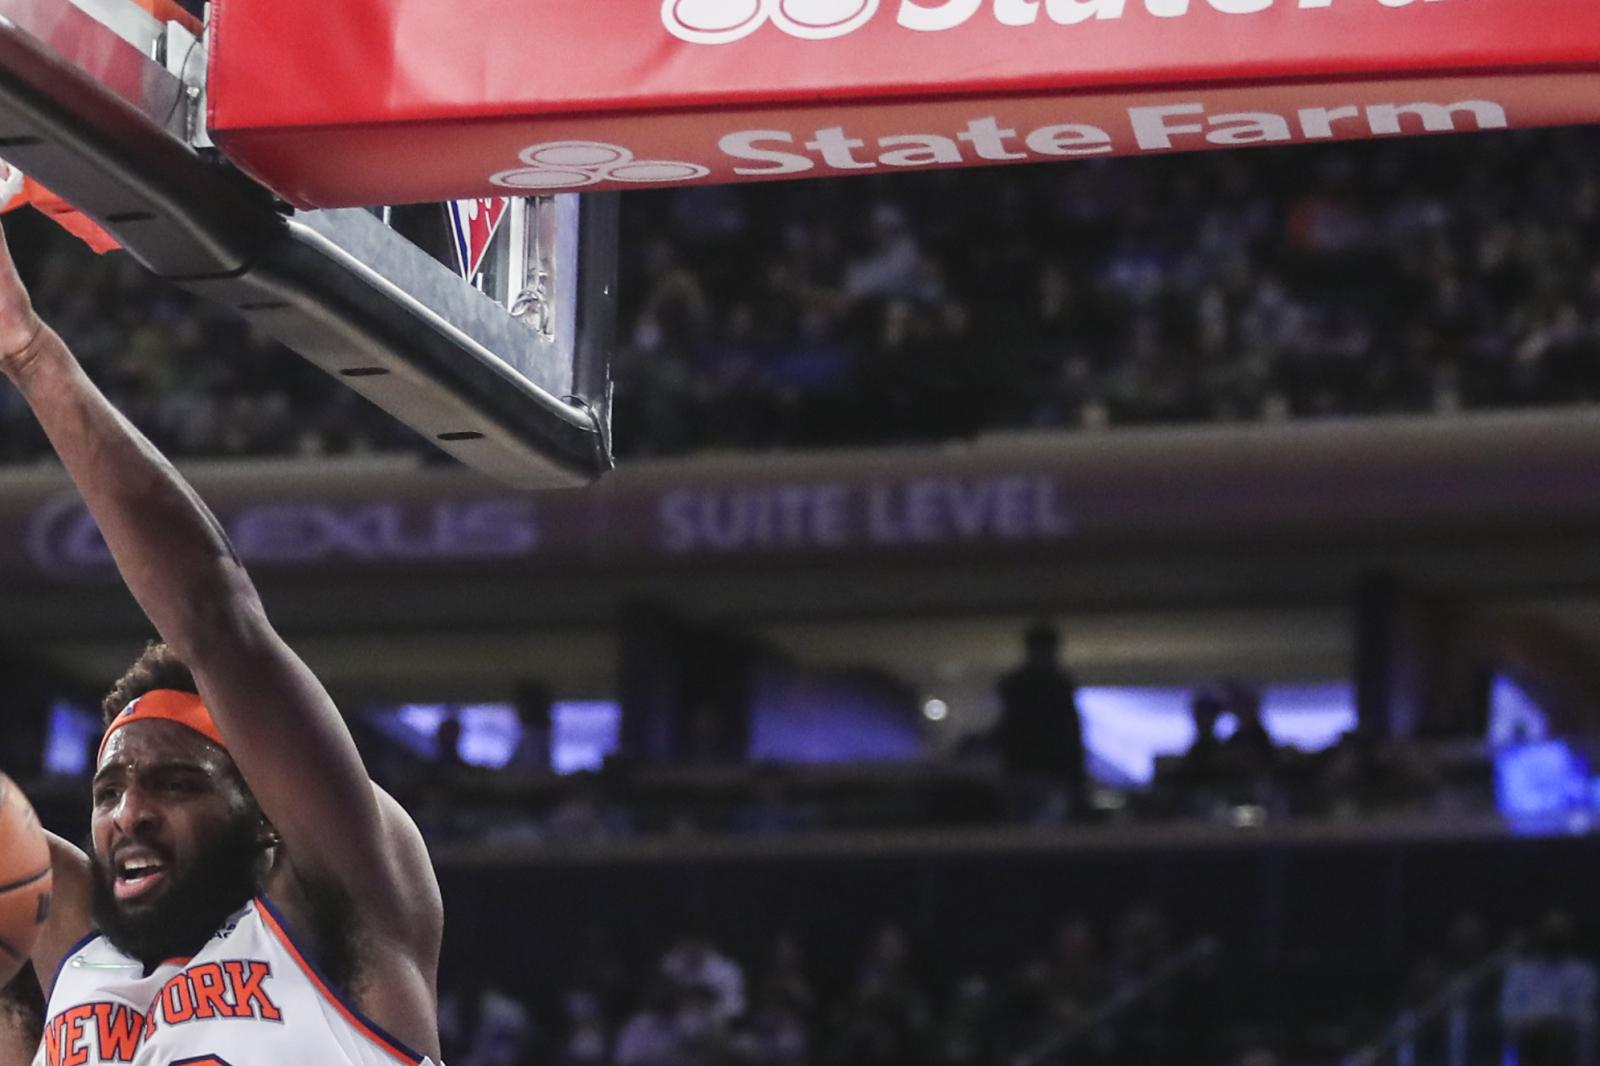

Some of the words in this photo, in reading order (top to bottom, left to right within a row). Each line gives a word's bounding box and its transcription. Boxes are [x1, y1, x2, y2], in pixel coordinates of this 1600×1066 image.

[230, 500, 539, 562] EXUS
[656, 484, 848, 552] SUITE
[866, 474, 1074, 543] LEVEL
